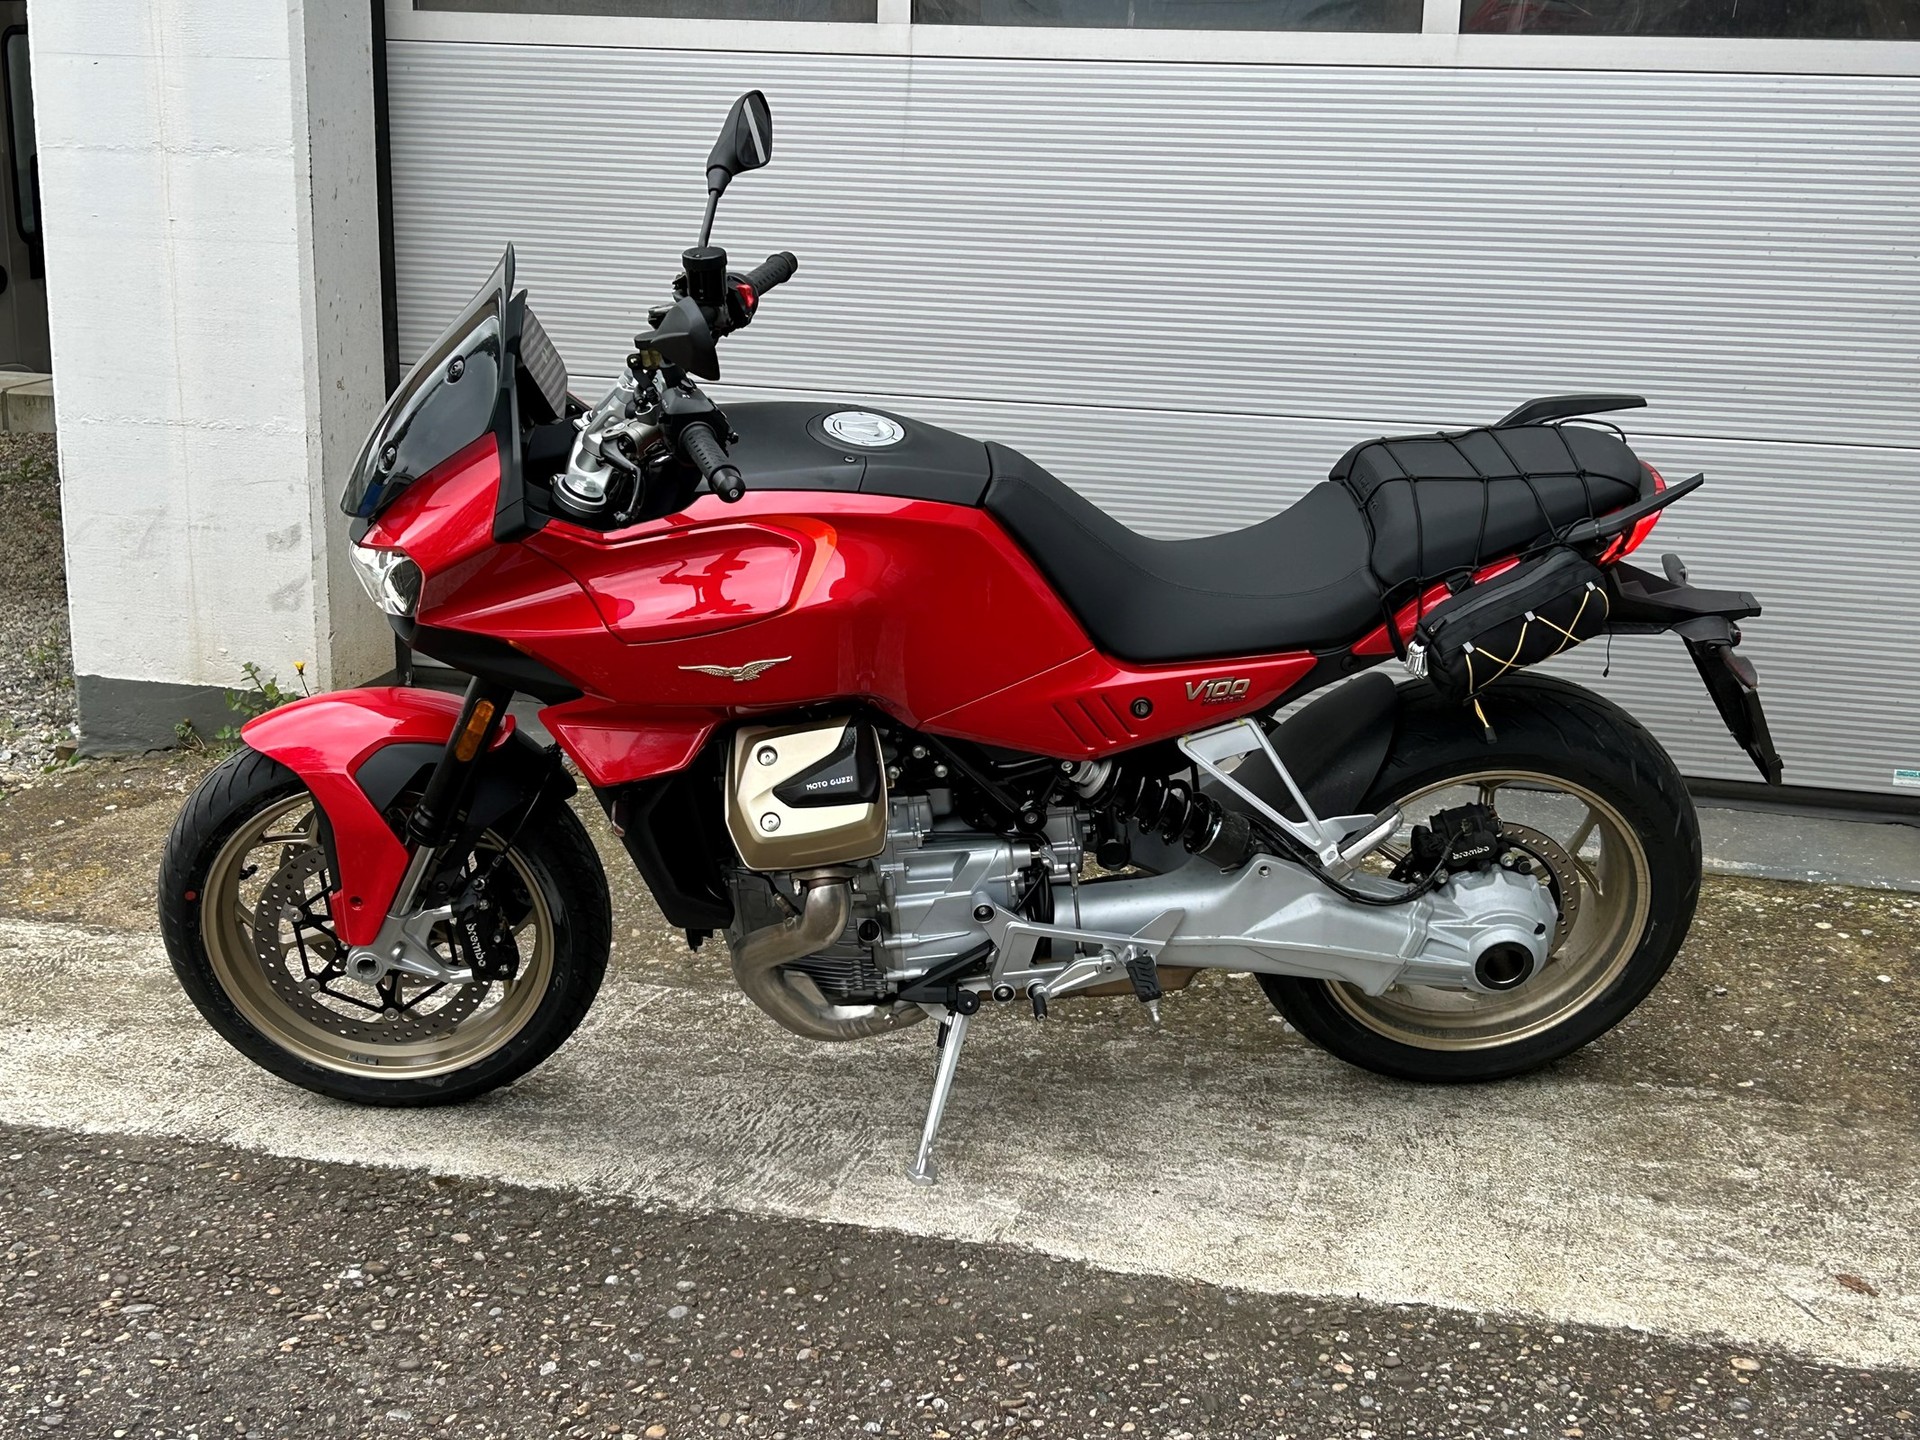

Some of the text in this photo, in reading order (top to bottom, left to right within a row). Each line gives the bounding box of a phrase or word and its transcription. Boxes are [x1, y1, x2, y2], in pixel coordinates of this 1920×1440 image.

[1185, 677, 1251, 700] V100
[806, 775, 853, 791] MOTO GUZZI
[1452, 845, 1490, 860] brembo
[465, 922, 487, 967] brembo
